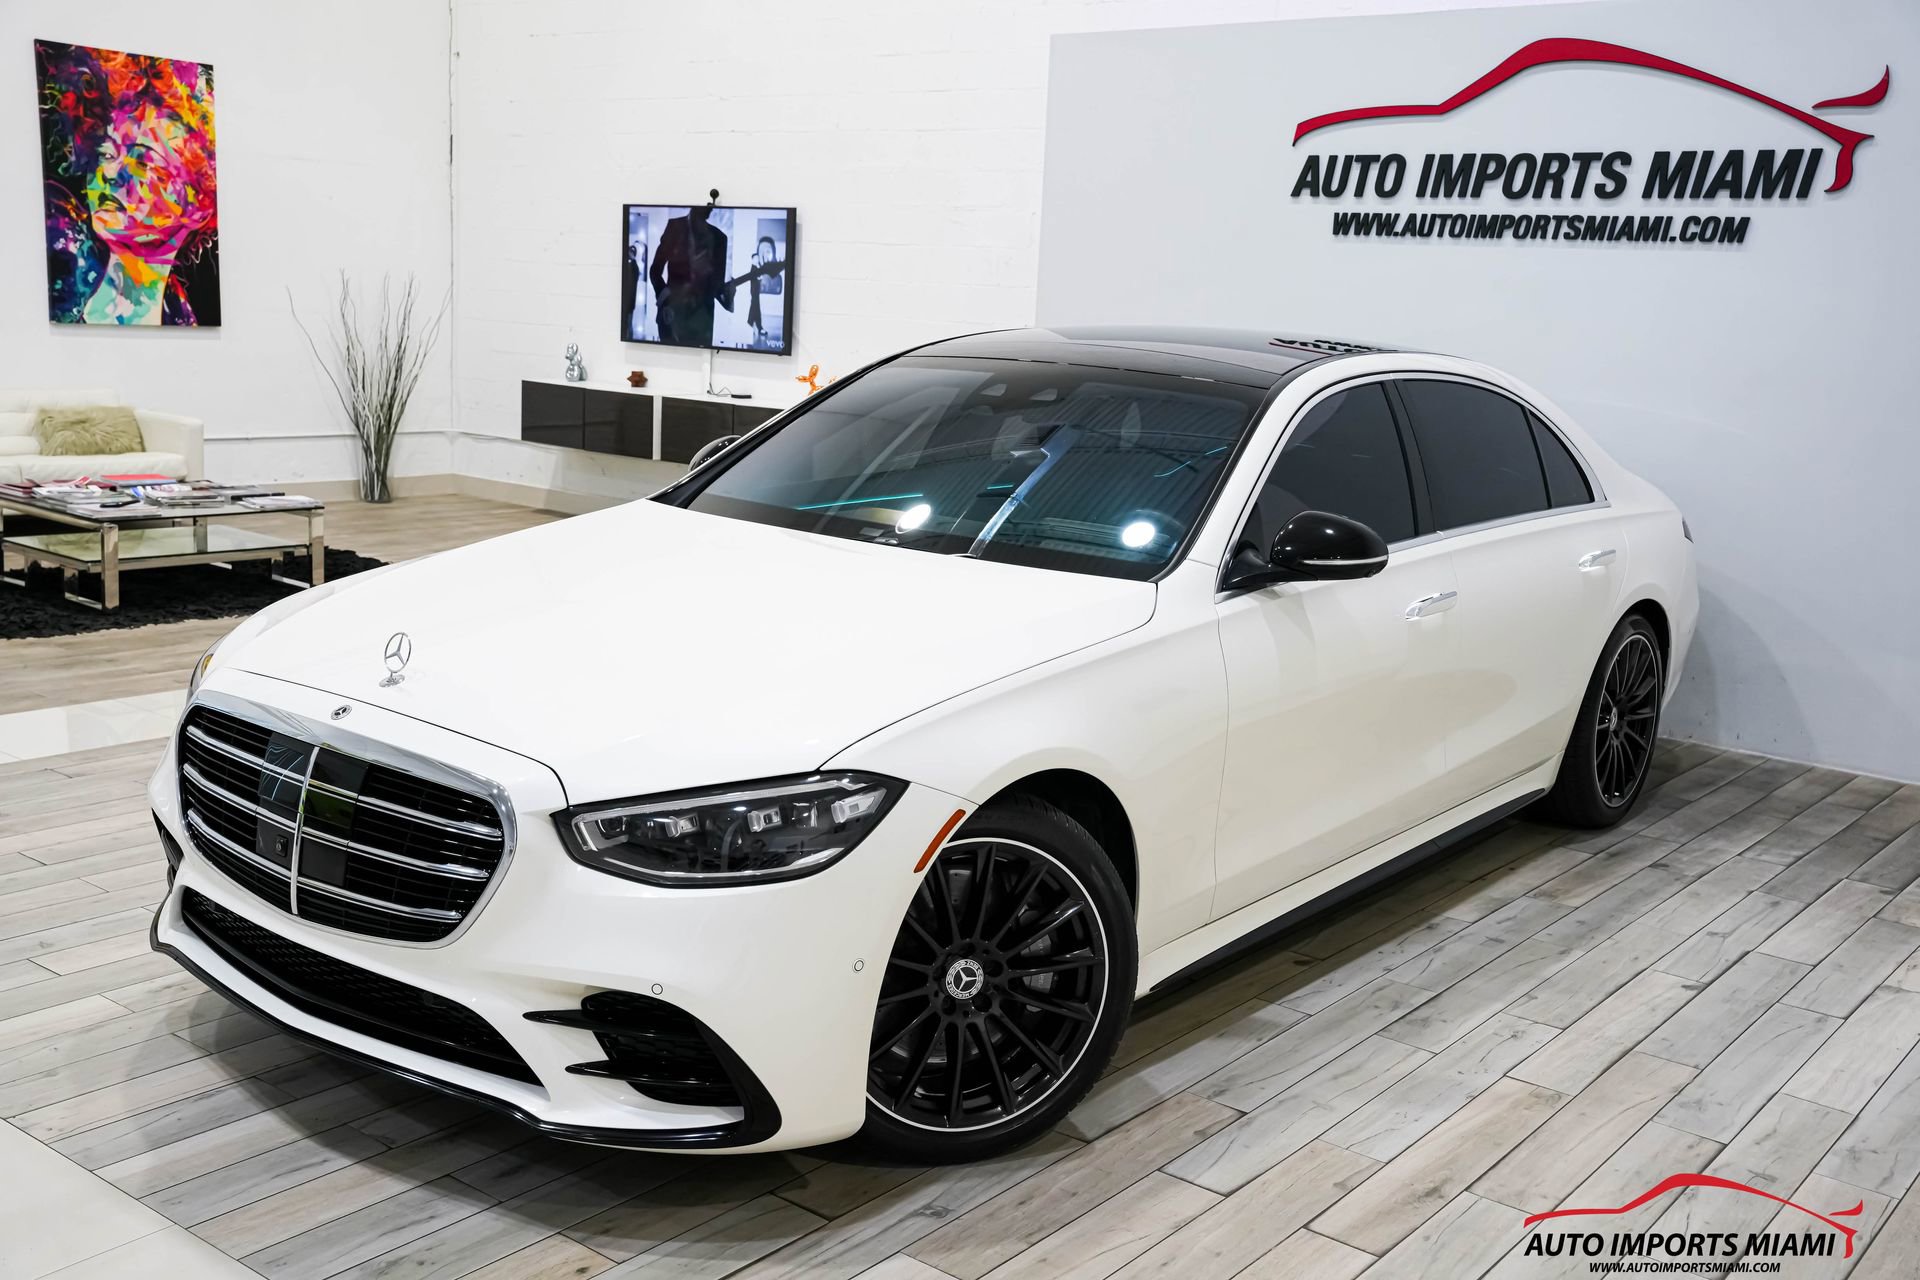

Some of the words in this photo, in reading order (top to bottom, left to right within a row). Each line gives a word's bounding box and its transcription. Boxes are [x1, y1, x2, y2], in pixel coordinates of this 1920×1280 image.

[1291, 153, 1407, 199] AUTO
[1416, 151, 1632, 200] IMPORTS
[1642, 148, 1824, 200] MIAMI
[1333, 212, 1751, 244] WWW.AUTOIMPORTSMIAMI.COM
